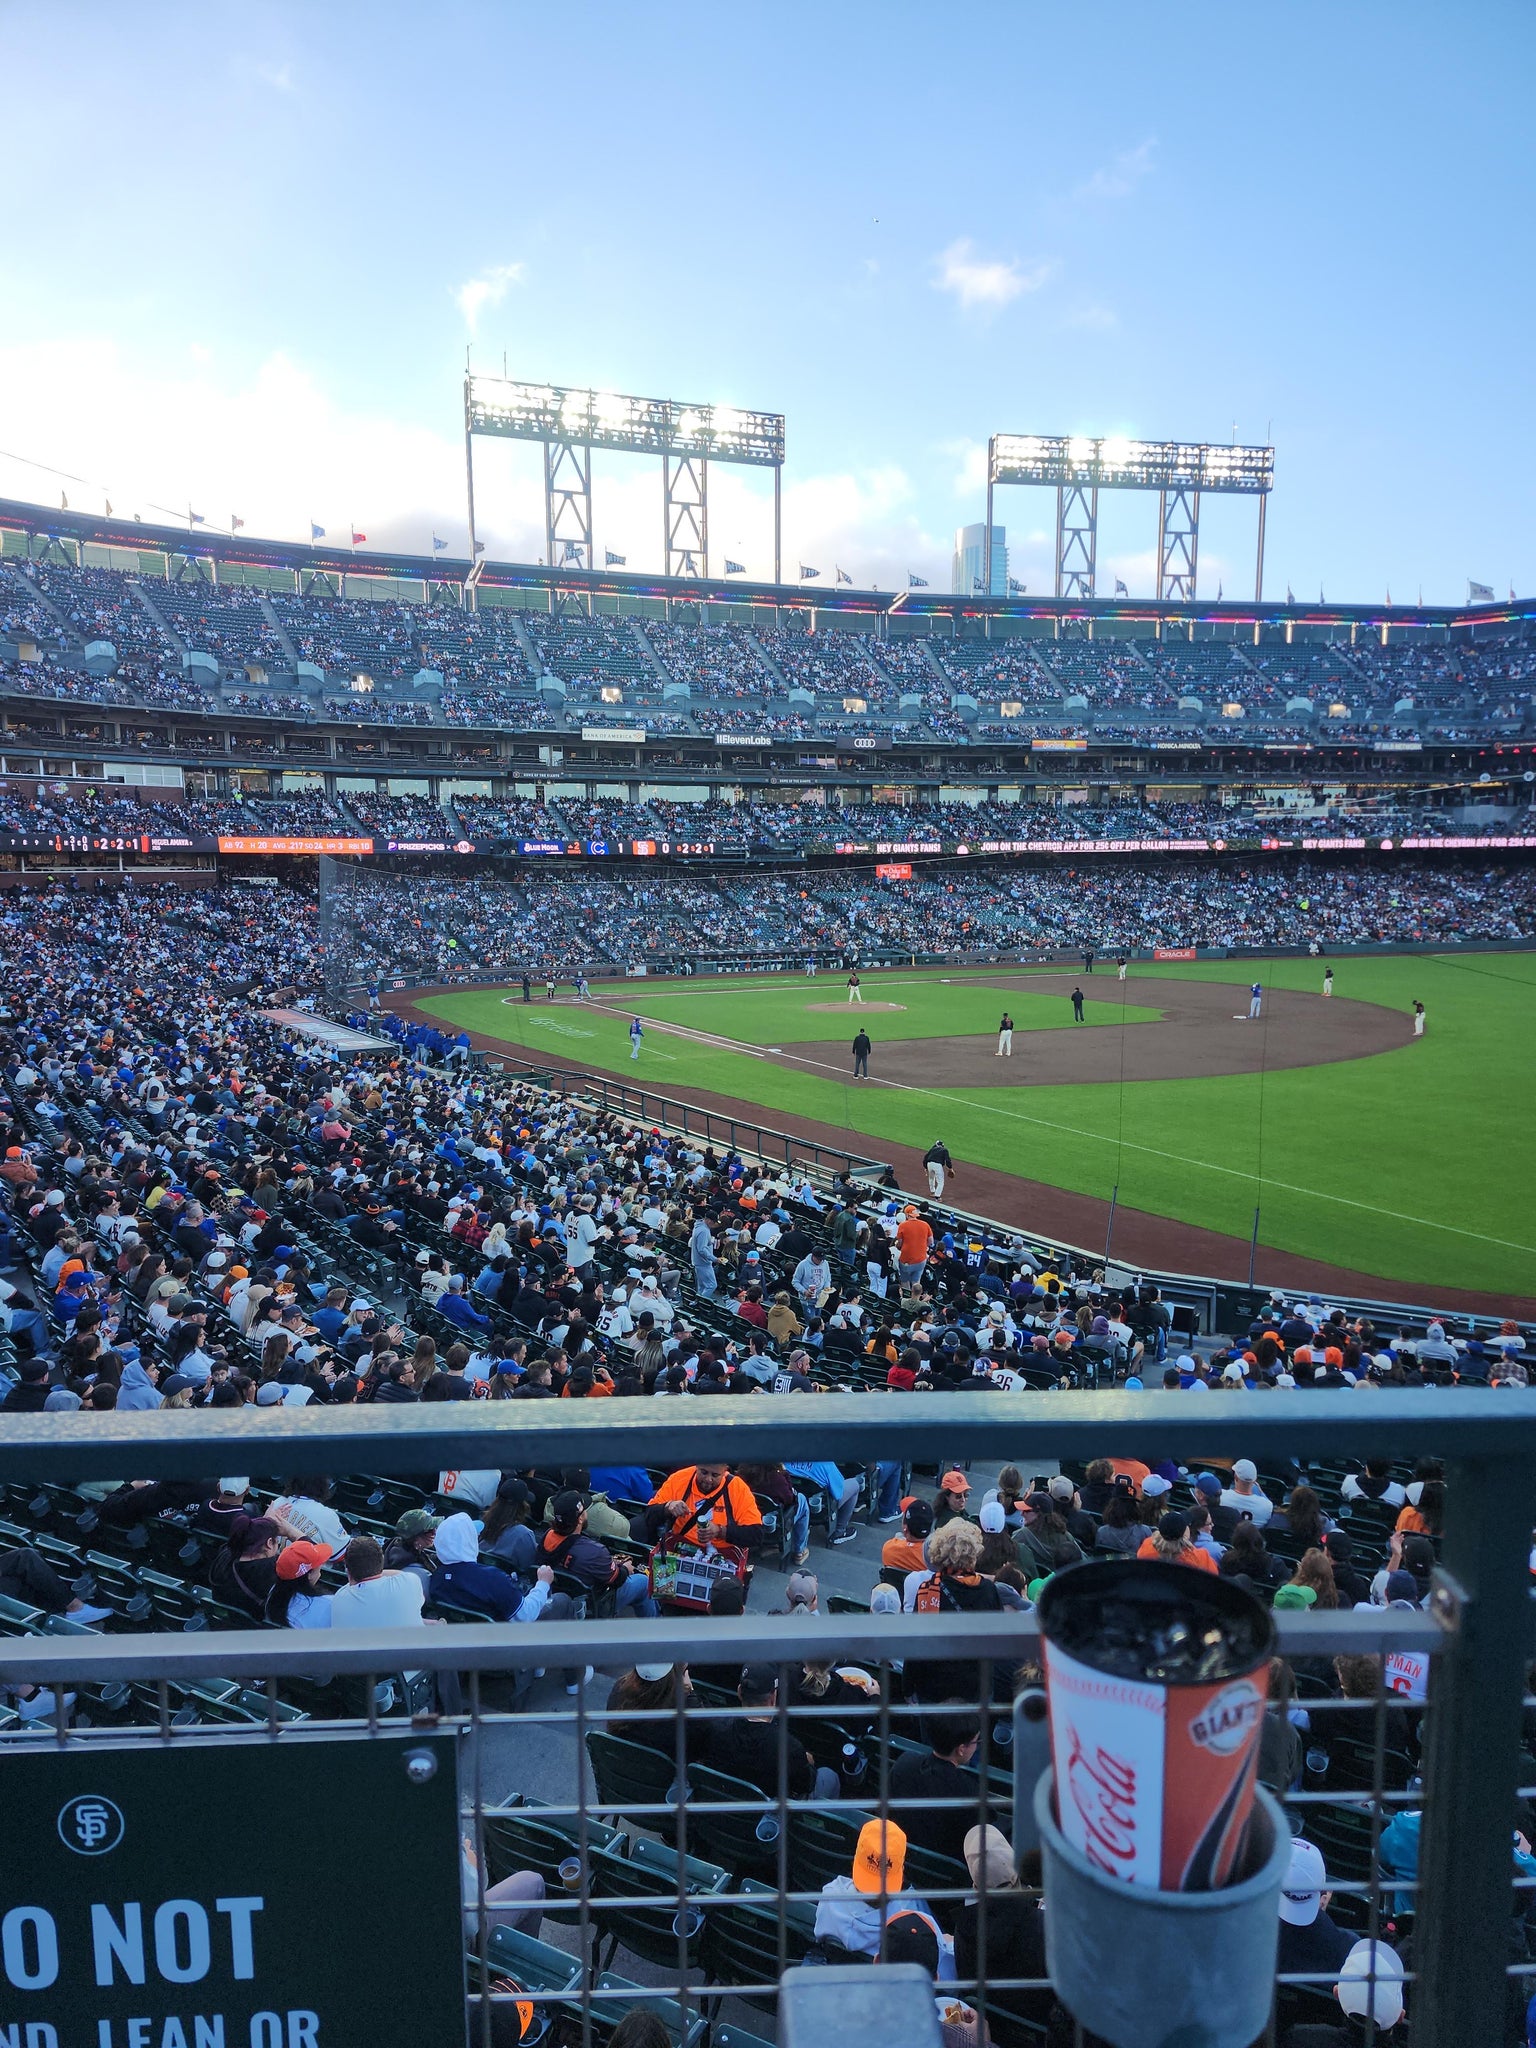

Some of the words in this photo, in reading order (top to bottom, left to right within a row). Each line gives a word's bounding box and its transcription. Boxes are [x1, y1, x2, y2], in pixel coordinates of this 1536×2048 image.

[69, 835, 75, 843] 3
[81, 835, 88, 843] 0
[100, 838, 108, 849] 2
[110, 840, 116, 848] S
[116, 838, 124, 849] 2
[132, 838, 138, 849] 1
[82, 843, 88, 851] 0
[573, 841, 580, 850] 2
[618, 843, 623, 853] 1
[662, 843, 669, 853] 0
[682, 843, 689, 853] 2
[695, 843, 702, 853] 2
[709, 843, 714, 853] 1
[876, 843, 892, 852] HEY
[893, 843, 919, 852] GIANTS
[920, 843, 941, 852] FANS!
[980, 842, 998, 851] JOIN
[1000, 842, 1011, 850] ON
[1012, 842, 1026, 850] THE
[1028, 842, 1064, 850] CHEVRON
[1064, 842, 1077, 850] APP
[1080, 842, 1094, 850] FOR
[1110, 841, 1124, 850] OFF
[1126, 841, 1140, 850] PER
[1141, 841, 1169, 850] GALLON
[568, 1225, 578, 1239] 55
[967, 1254, 981, 1267] 24
[996, 1374, 1013, 1391] 26
[90, 1896, 264, 1986] NOT
[249, 2009, 320, 2048] OR
